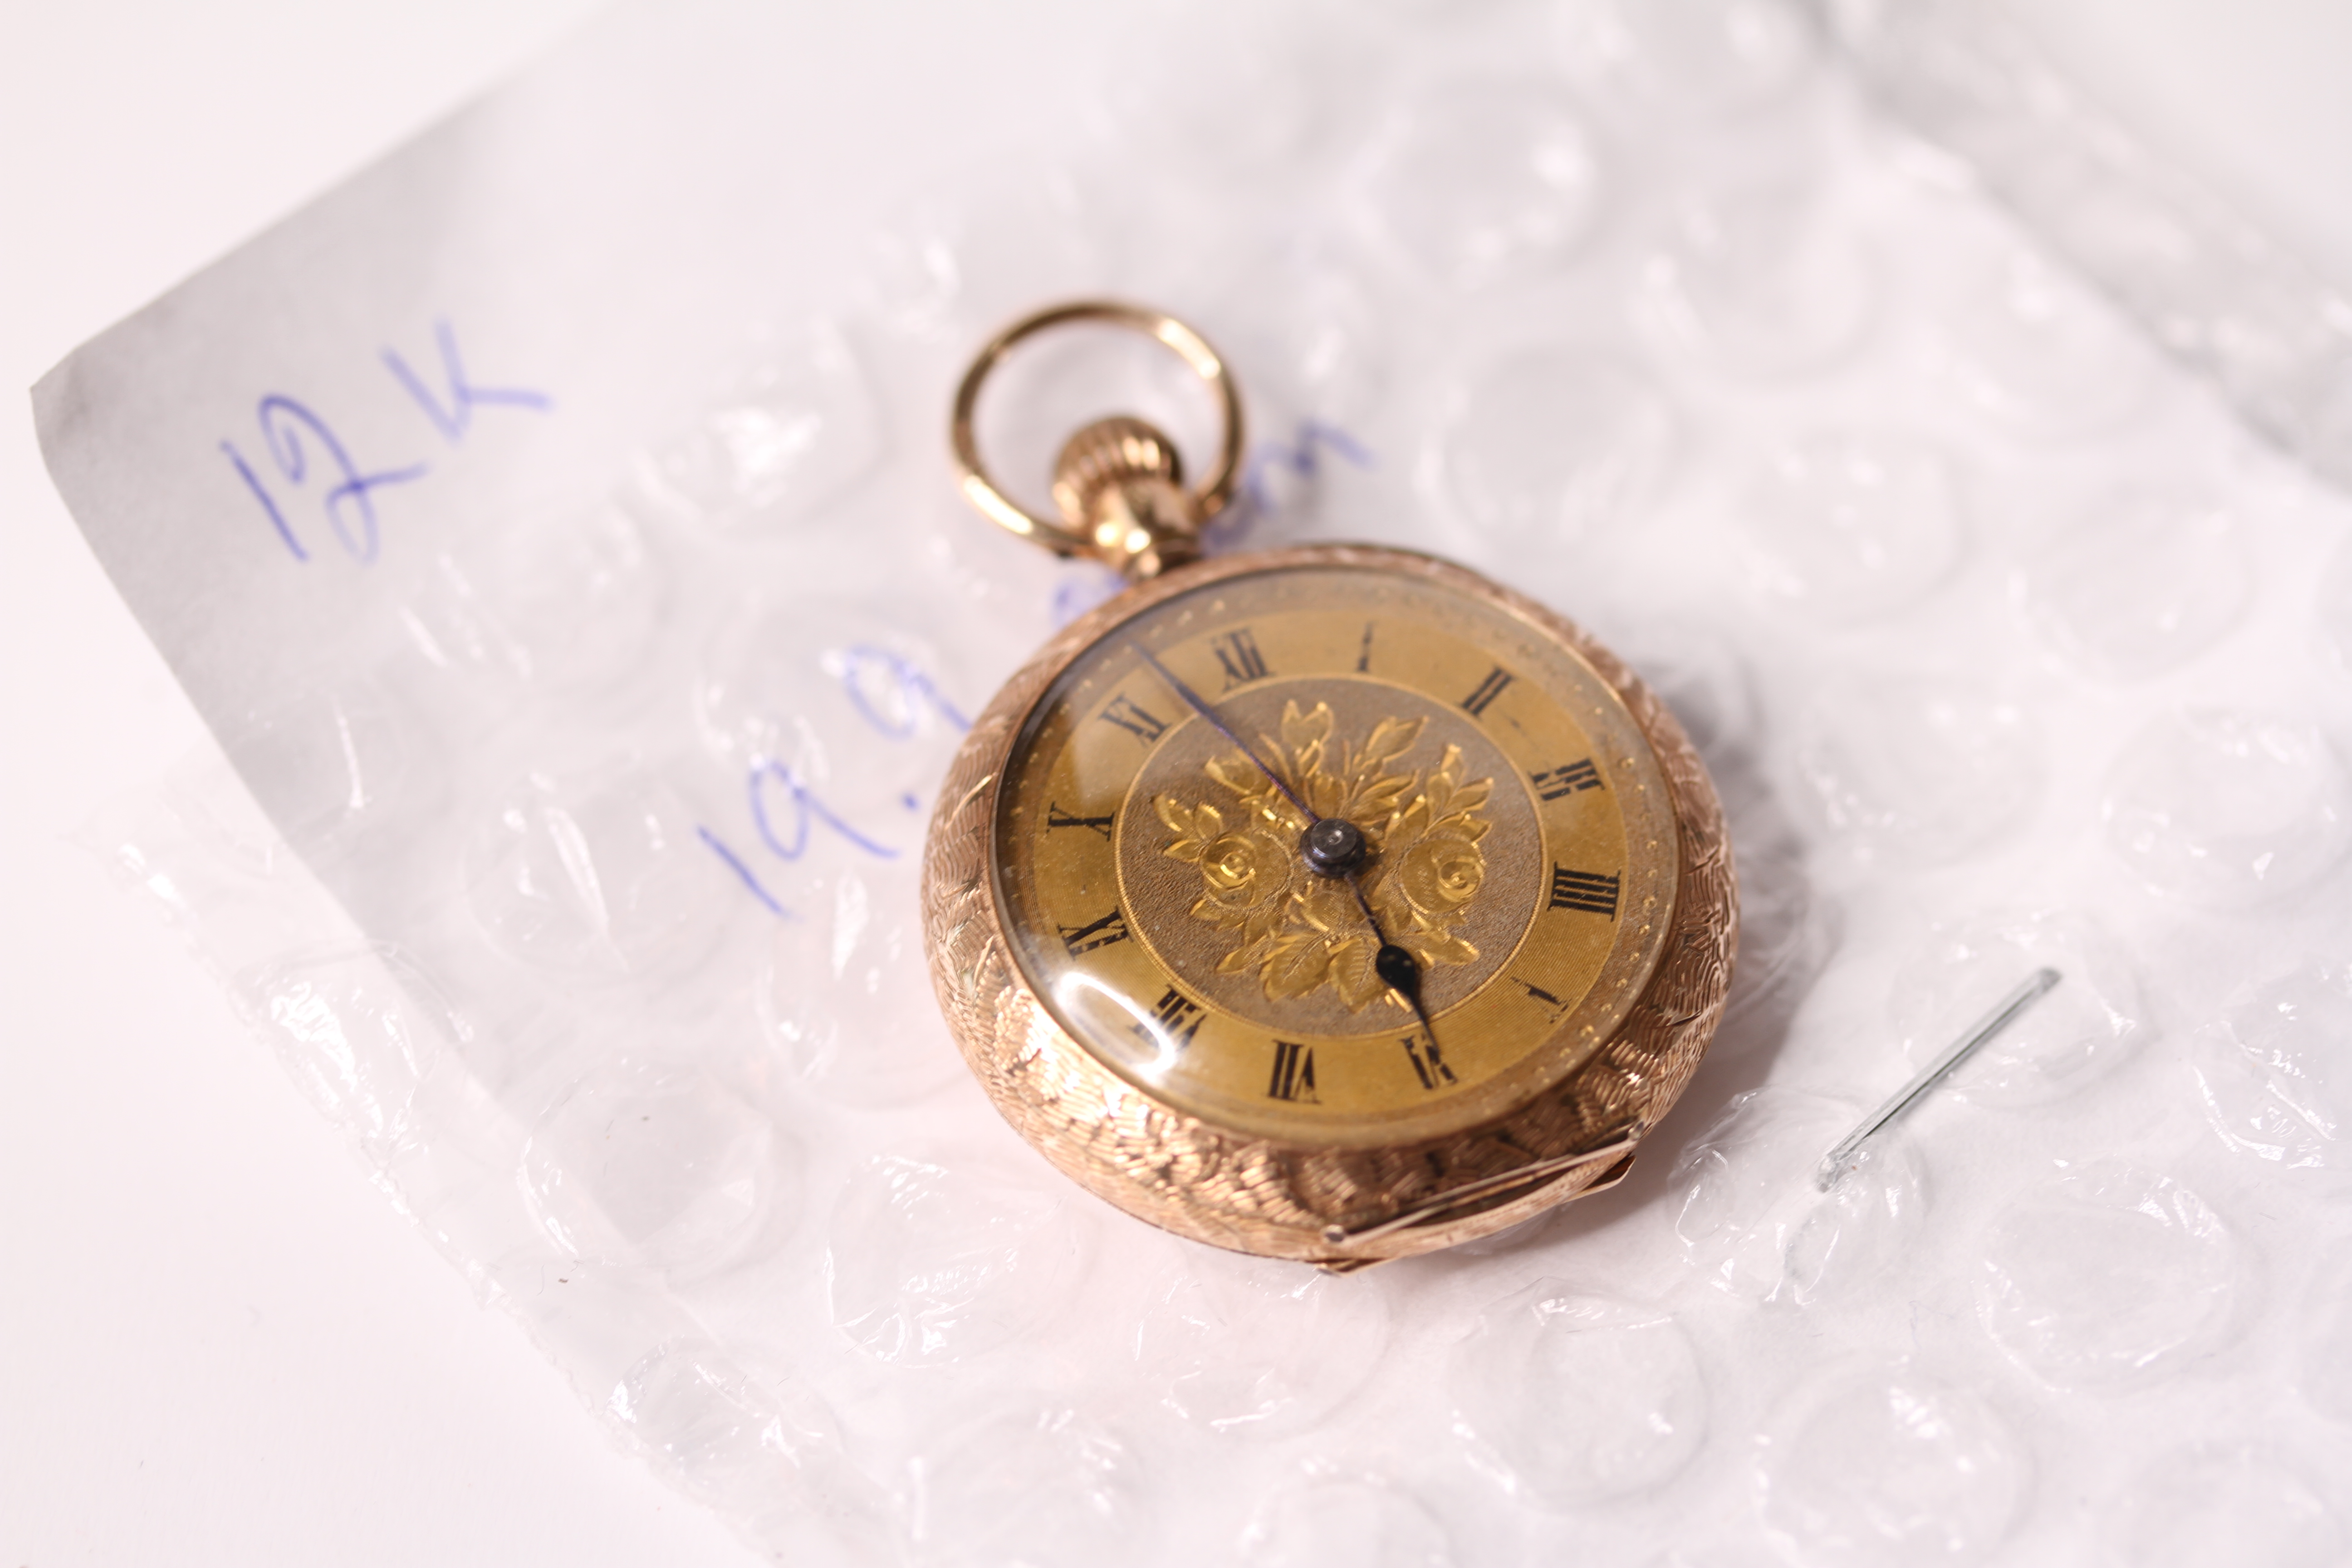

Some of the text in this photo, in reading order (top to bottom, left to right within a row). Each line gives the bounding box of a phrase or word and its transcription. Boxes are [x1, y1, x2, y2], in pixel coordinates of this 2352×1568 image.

[219, 393, 431, 565] 12
[1210, 627, 1275, 694] XII
[1096, 691, 1174, 748] XI
[1457, 664, 1514, 720] II
[1527, 757, 1606, 801] III
[1046, 801, 1115, 842] X
[1546, 861, 1622, 922] IIII
[1267, 1039, 1322, 1104] VII
